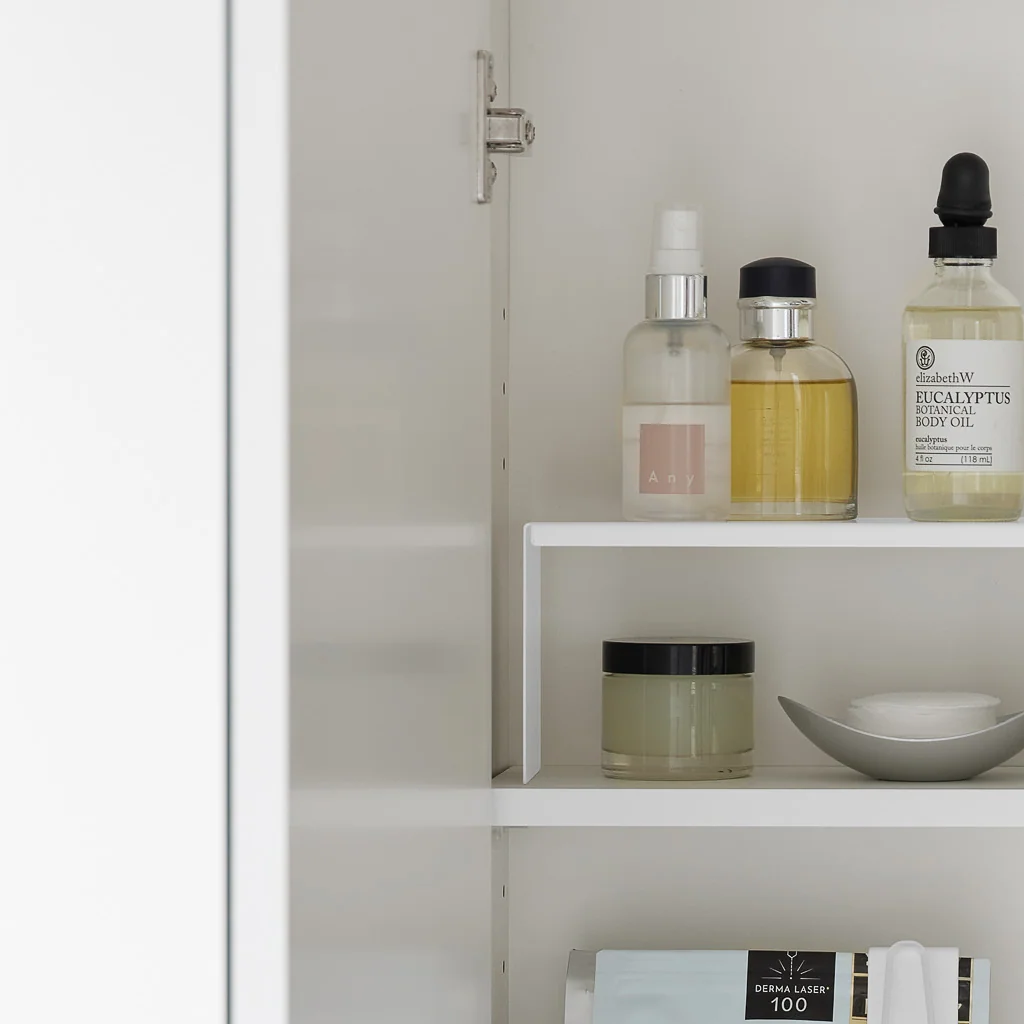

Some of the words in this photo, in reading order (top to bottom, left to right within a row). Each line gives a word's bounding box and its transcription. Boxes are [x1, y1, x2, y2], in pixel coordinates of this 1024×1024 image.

[916, 372, 974, 384] elizabethW
[916, 390, 1011, 404] EUCALYPTUS
[916, 405, 976, 415] BOTANICAL
[916, 416, 948, 427] BODY
[950, 416, 974, 428] OIL
[916, 434, 948, 444] eucalyptus
[927, 444, 954, 452] botanique
[960, 455, 978, 464] (118
[648, 470, 694, 488] Any
[755, 984, 791, 993] DERMA
[794, 985, 826, 994] LASER
[771, 997, 807, 1012] 100
